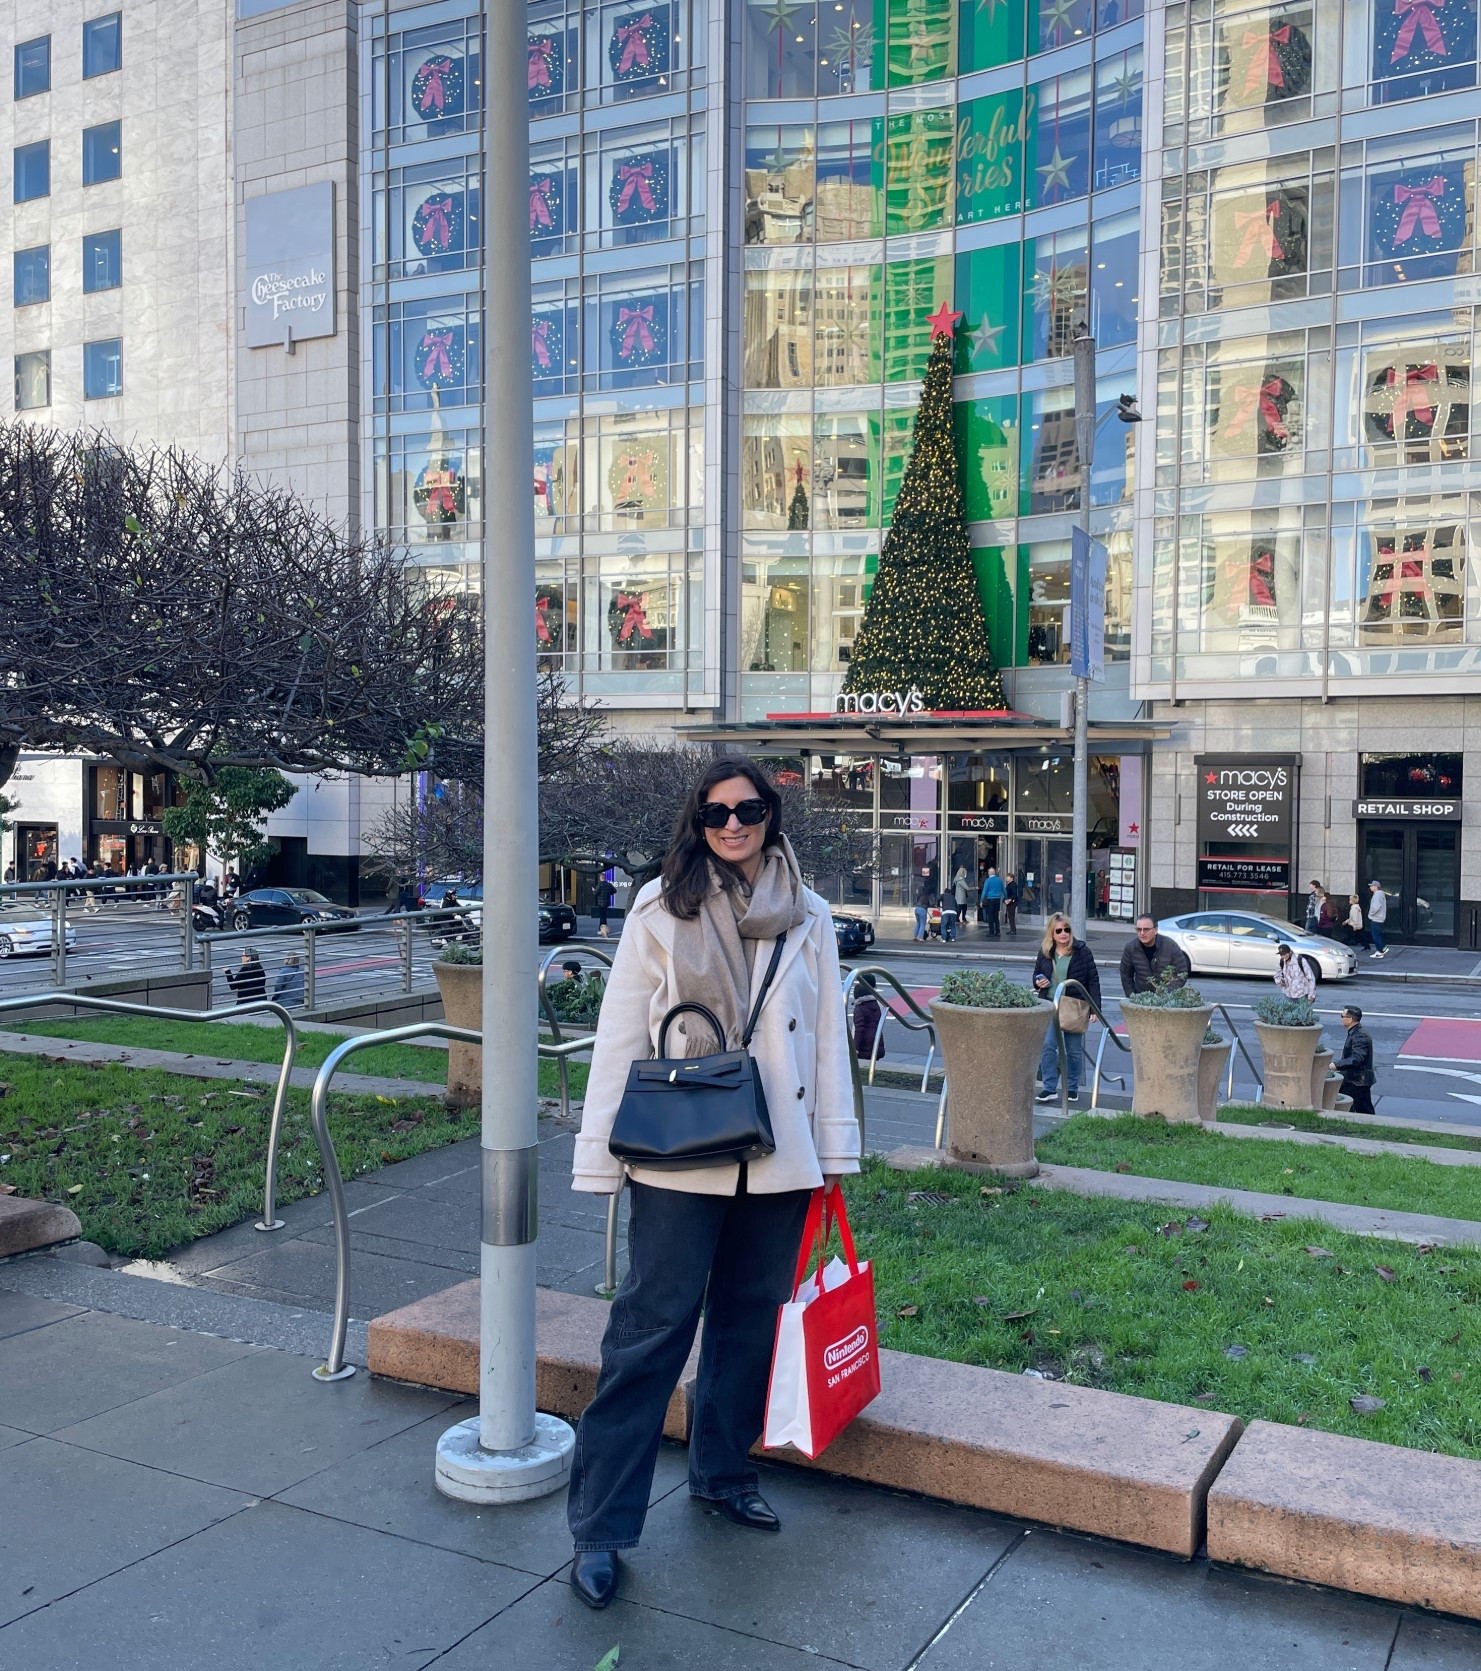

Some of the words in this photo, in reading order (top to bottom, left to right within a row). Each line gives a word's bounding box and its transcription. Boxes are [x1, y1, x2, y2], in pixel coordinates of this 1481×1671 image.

[875, 119, 905, 130] THE
[915, 110, 955, 124] MOST
[873, 93, 1035, 184] Wonderful
[903, 156, 1013, 228] Stories
[936, 209, 984, 225] START
[994, 199, 1031, 214] HERE
[251, 267, 326, 305] Cheesecake
[265, 291, 327, 321] Factory
[834, 683, 924, 717] macy's
[1220, 767, 1287, 789] macy's
[1207, 790, 1246, 800] STORE
[1249, 790, 1283, 801] OPEN
[1226, 802, 1263, 813] During
[1210, 811, 1279, 822] Construction
[1357, 803, 1409, 814] RETAIL
[1412, 804, 1454, 815] SHOP
[1207, 863, 1235, 871] RETAIL
[1237, 864, 1254, 872] FOR
[1256, 865, 1282, 873] LEASE
[1218, 871, 1270, 880] 415.773.3546
[828, 1334, 864, 1364] Nintendo
[827, 1373, 840, 1388] SAN
[841, 1352, 869, 1379] FRANCISCO
